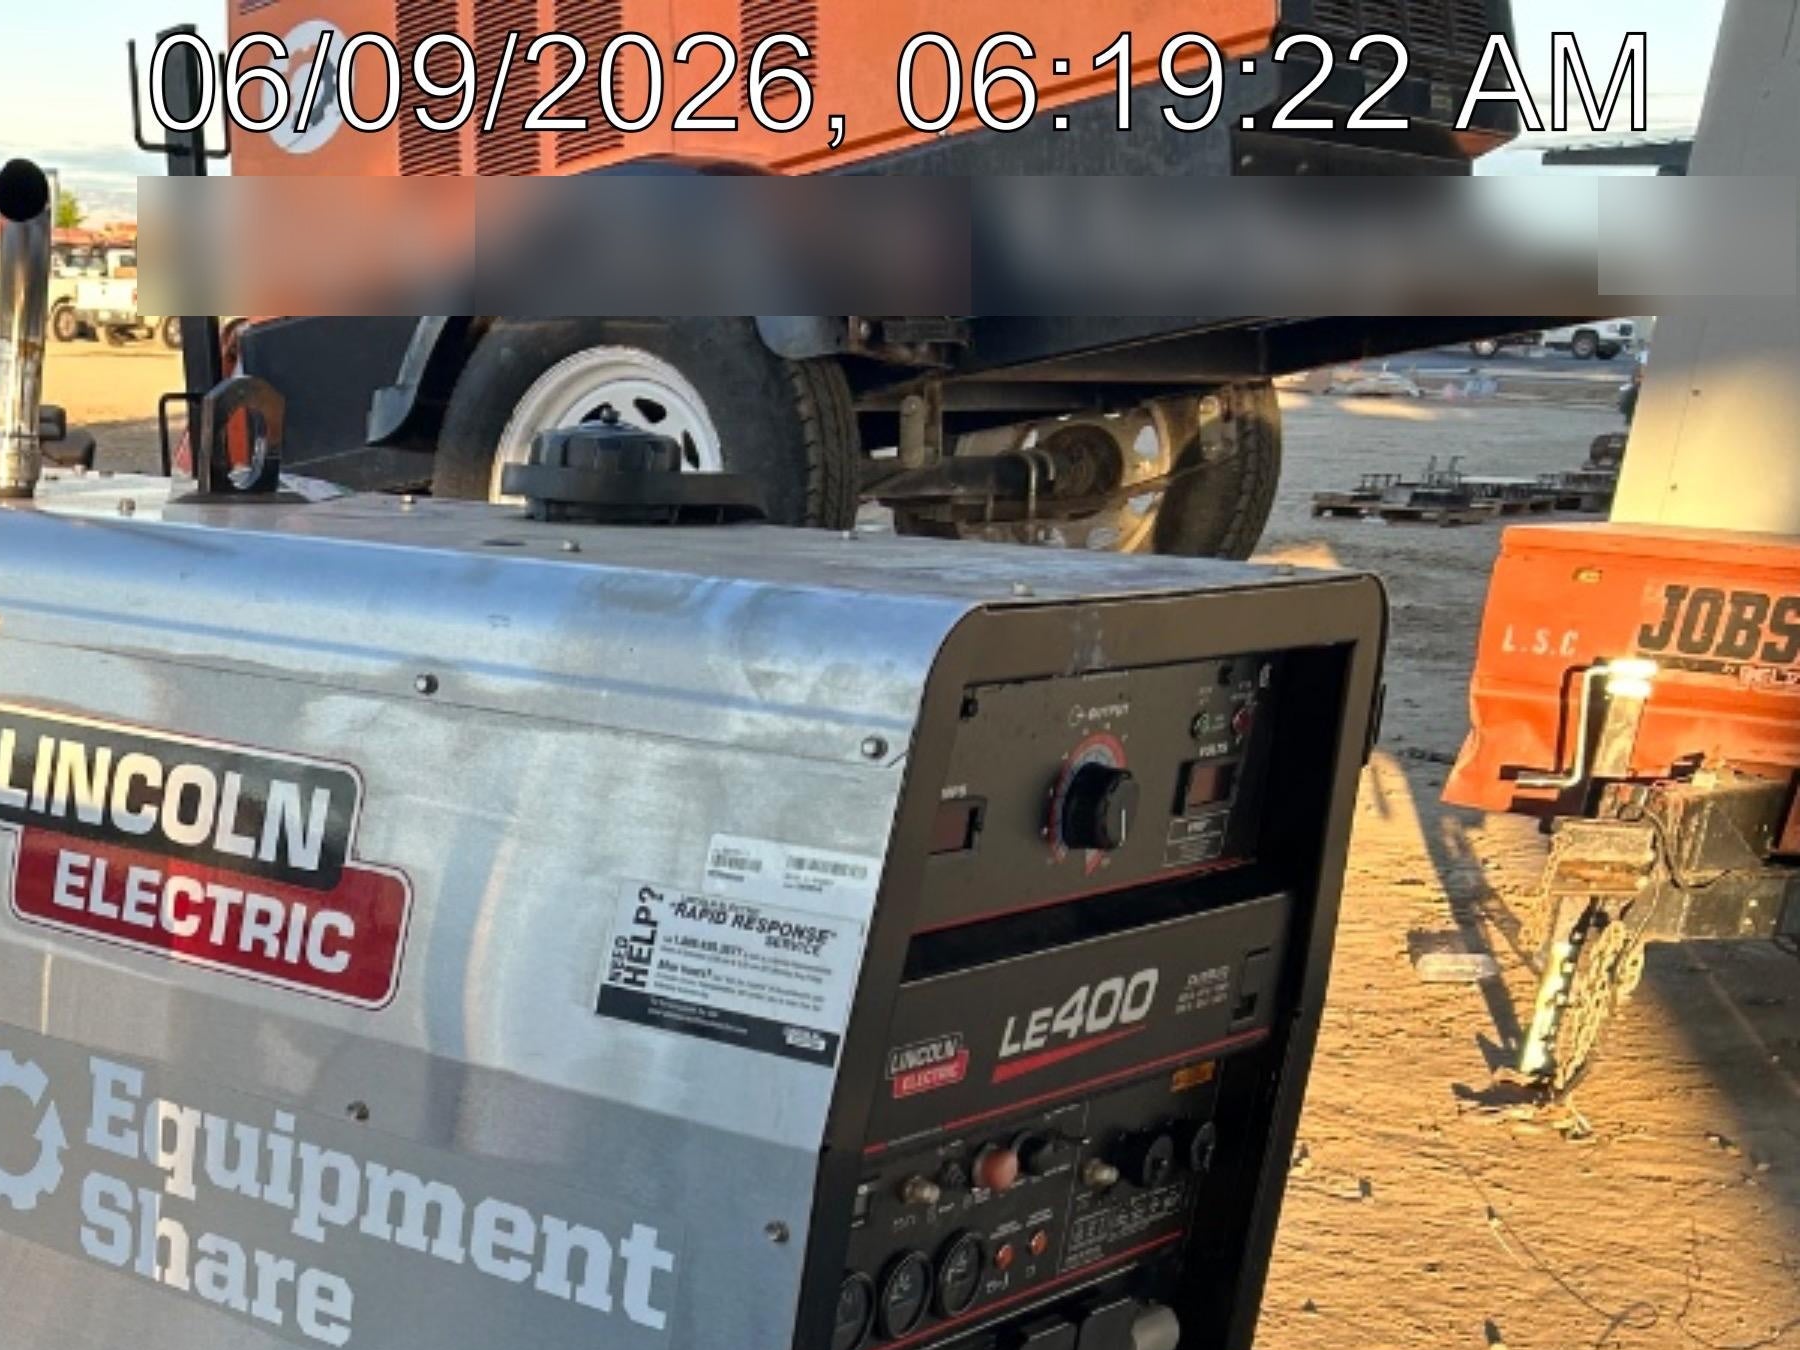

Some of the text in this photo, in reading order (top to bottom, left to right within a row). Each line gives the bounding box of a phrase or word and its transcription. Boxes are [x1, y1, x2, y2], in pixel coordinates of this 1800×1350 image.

[52, 848, 356, 974] ELECTRIC
[623, 886, 664, 988] HELP?
[891, 1037, 958, 1075] LINCOLN
[998, 967, 1160, 1059] LE400
[84, 1055, 676, 1331] Equipment
[79, 1171, 354, 1350] Share
